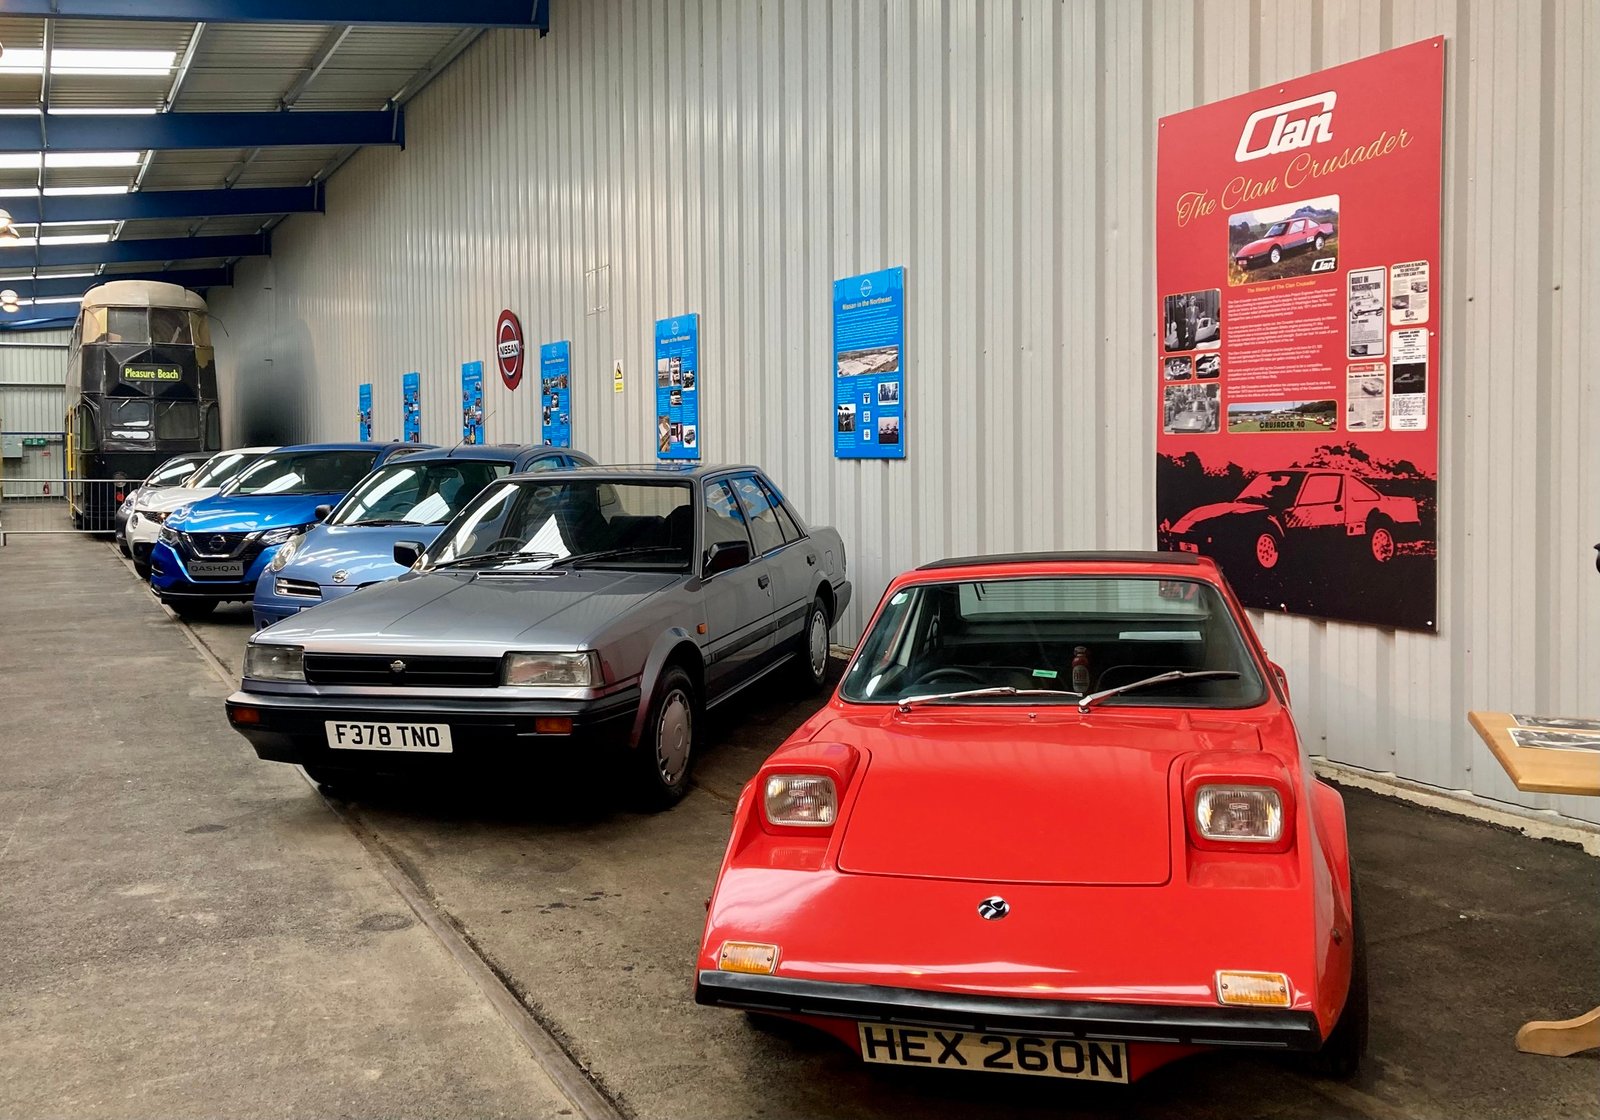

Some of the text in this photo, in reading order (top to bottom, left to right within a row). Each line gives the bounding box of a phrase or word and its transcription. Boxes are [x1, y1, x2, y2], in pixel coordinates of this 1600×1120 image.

[1235, 90, 1338, 163] Clan
[1176, 128, 1414, 228] The Clan Crusader
[1311, 257, 1336, 271] Clan
[500, 343, 519, 355] NISSAN
[125, 368, 179, 379] Pleasure Beach
[1260, 421, 1295, 429] CRUSADER
[335, 724, 440, 747] F378 TNO
[864, 1026, 1123, 1078] HEX 260N
